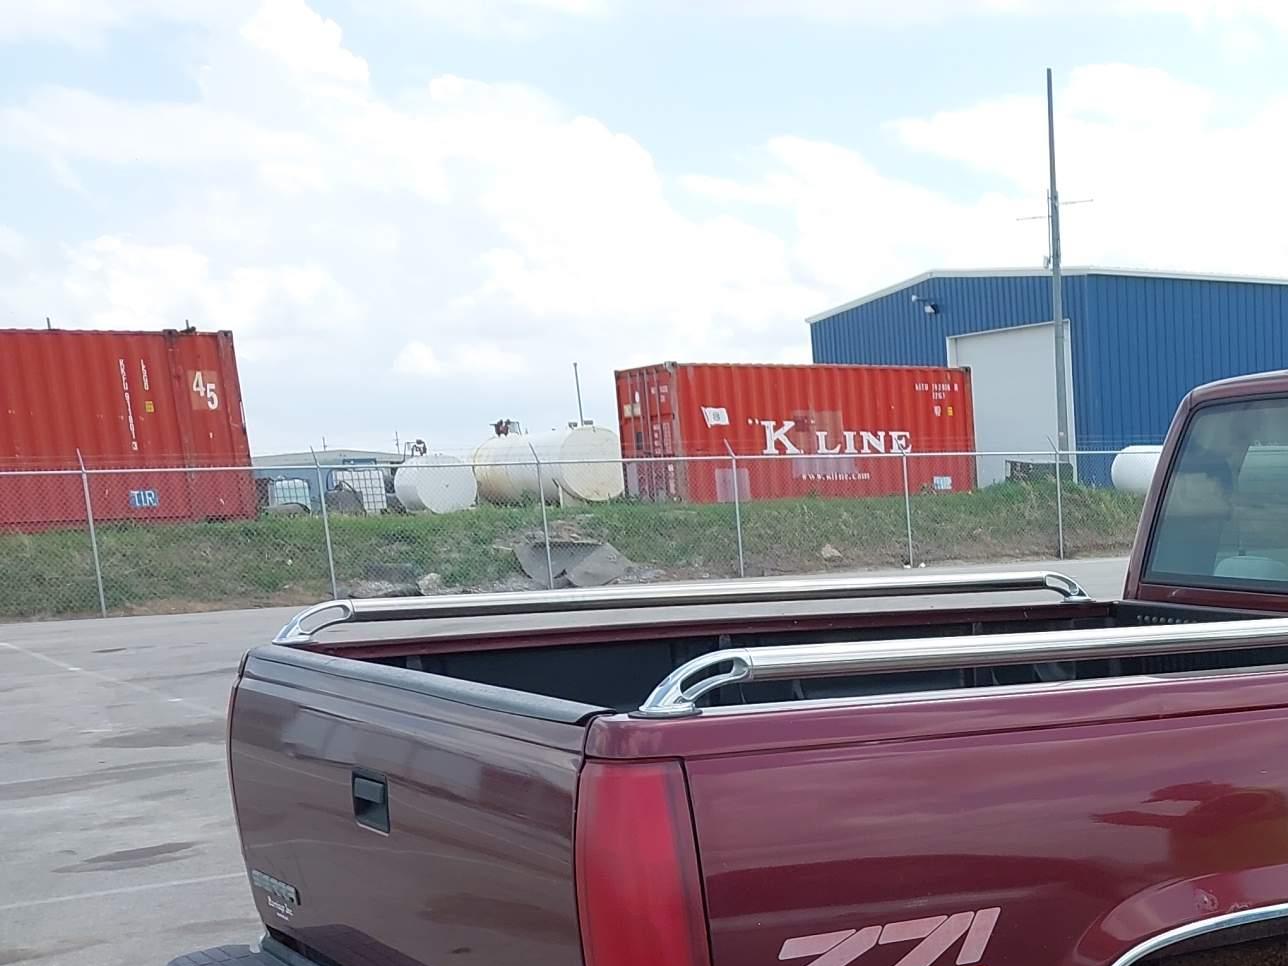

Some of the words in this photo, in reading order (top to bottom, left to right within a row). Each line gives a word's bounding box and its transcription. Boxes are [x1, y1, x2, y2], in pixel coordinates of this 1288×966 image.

[192, 371, 218, 410] 45
[816, 431, 912, 454] LINE
[130, 490, 157, 507] TIR
